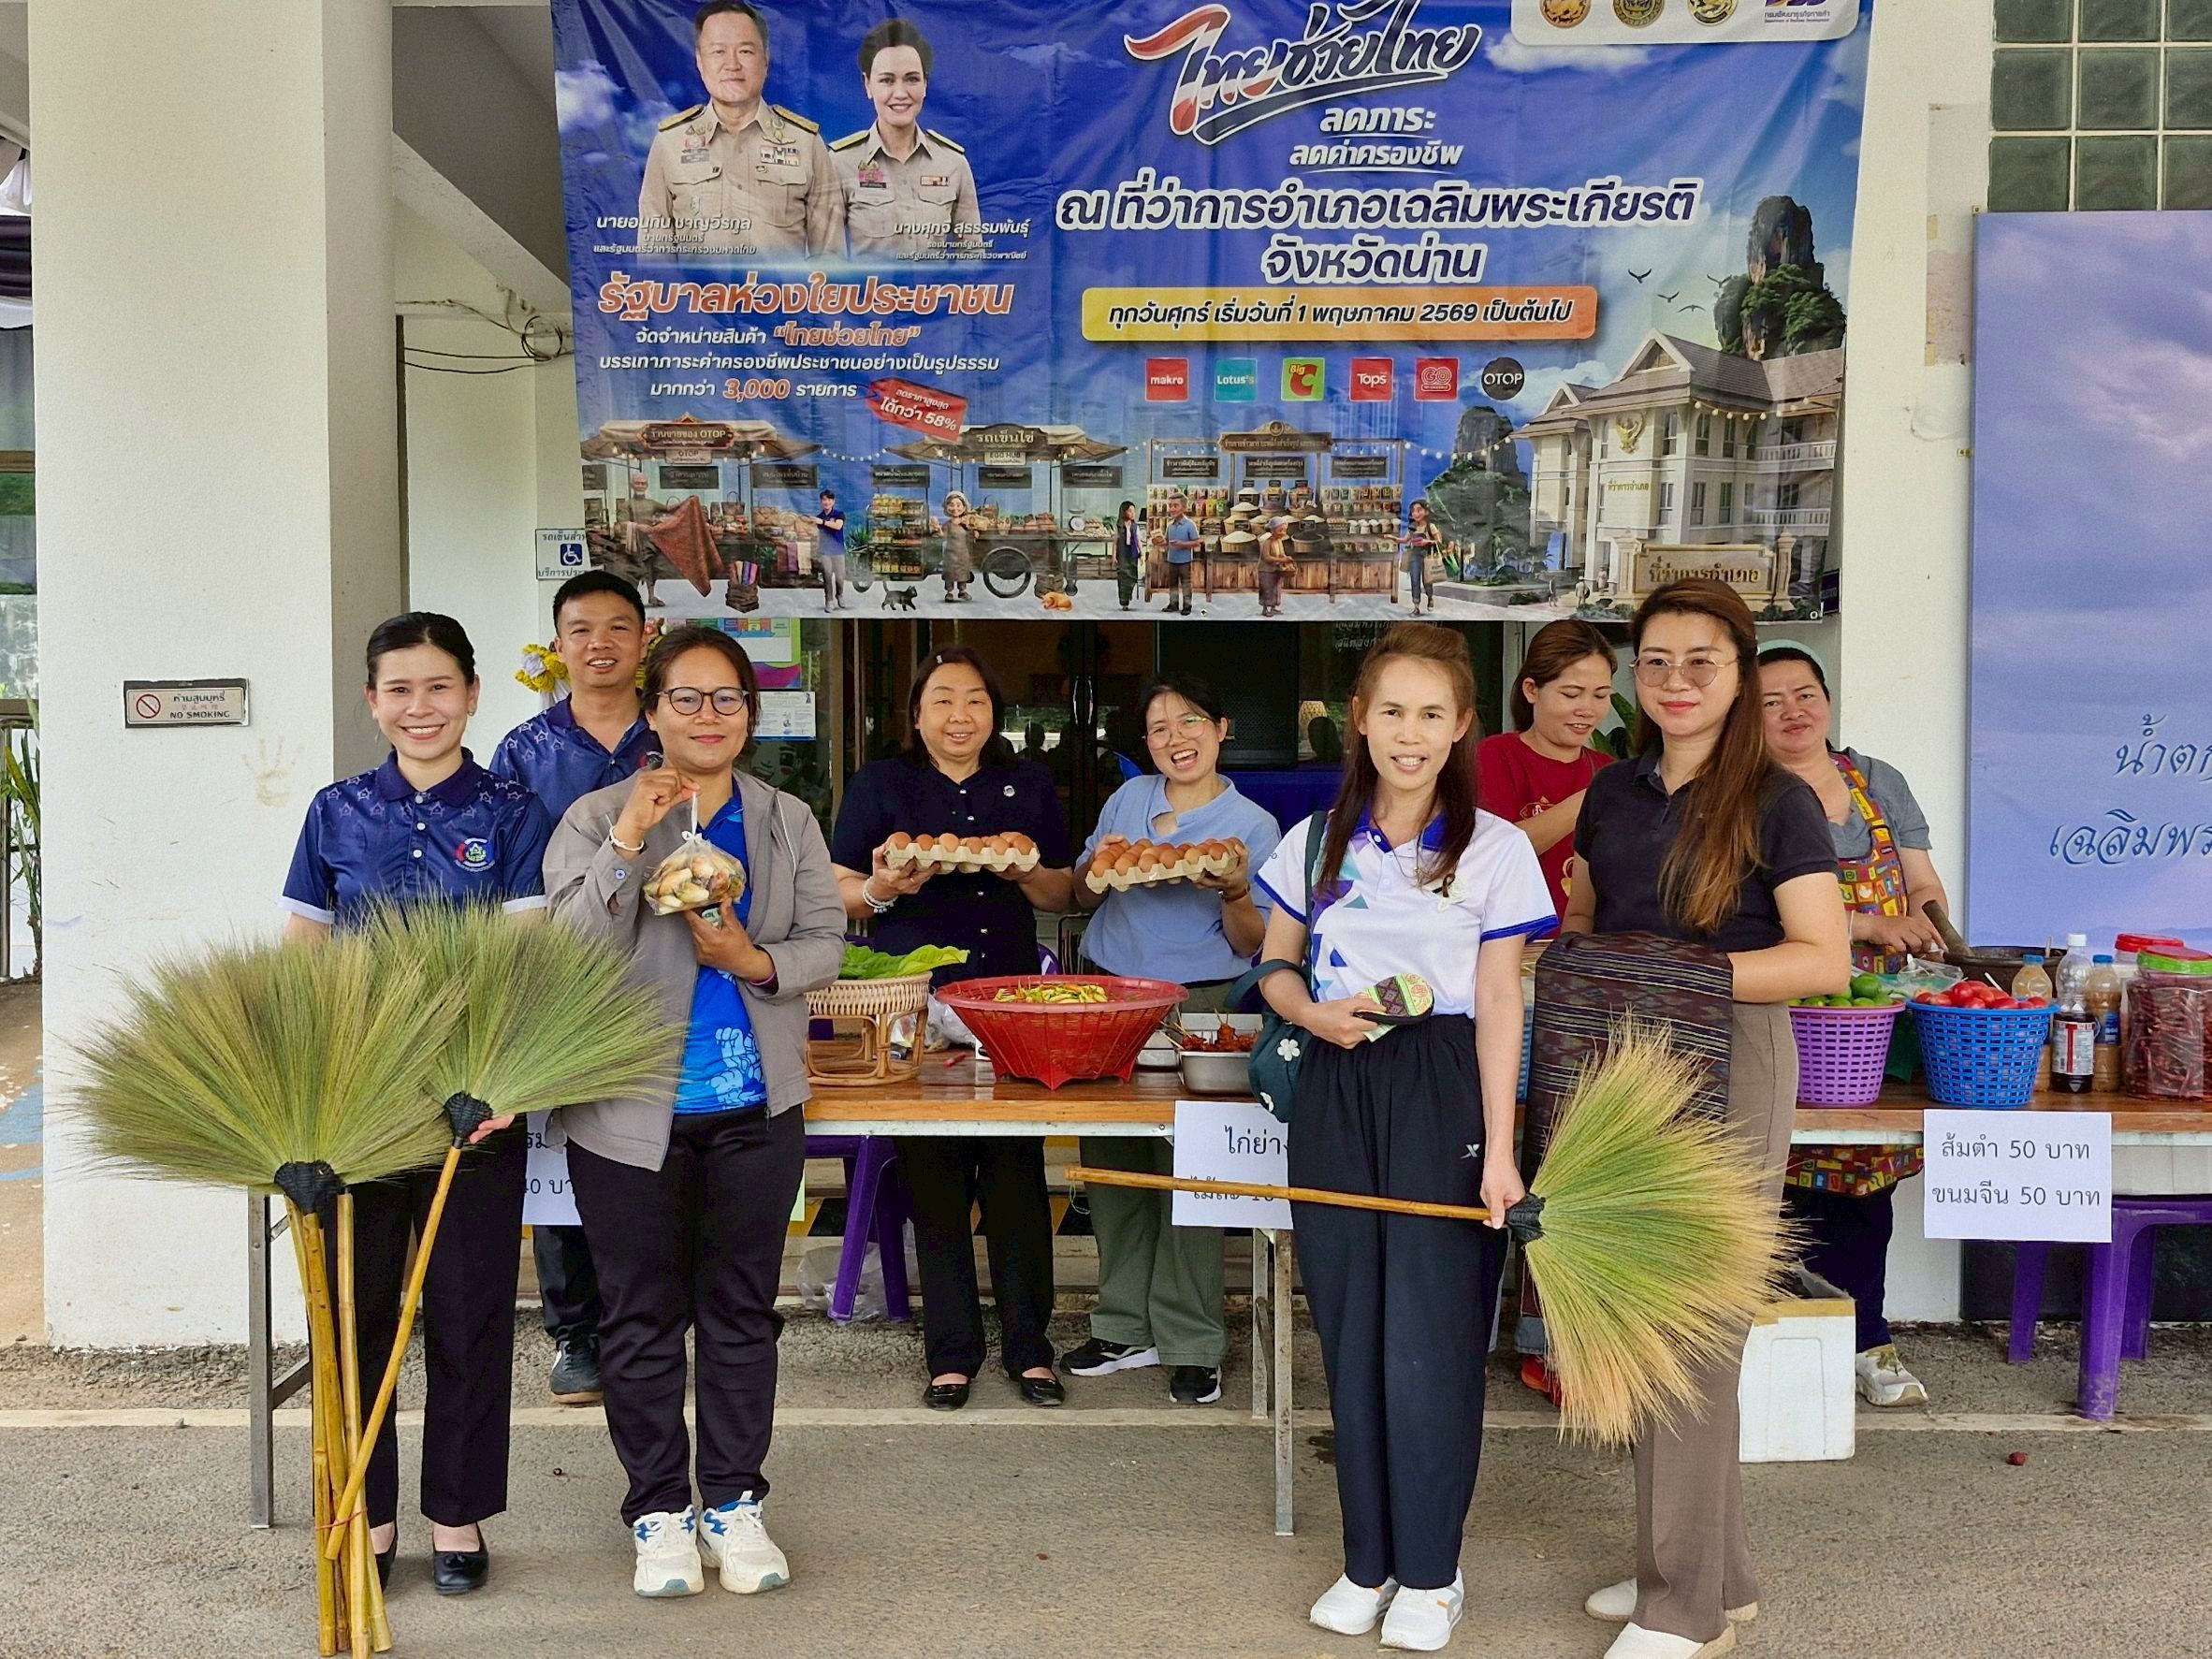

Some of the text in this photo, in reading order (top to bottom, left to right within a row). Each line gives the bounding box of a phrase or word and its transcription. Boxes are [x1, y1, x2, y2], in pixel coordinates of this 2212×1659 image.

[1125, 0, 1482, 136] ไทยช่วยไทย
[1319, 106, 1437, 133] ลดภาระ
[1289, 139, 1463, 167] ลดค่าครองชีพ
[1058, 169, 1702, 229] ณ ที่ว่าการอำเภอเฉลิมพระเกียรติ
[1263, 234, 1486, 283] จังหวัดน่าน
[598, 270, 1015, 322] รัฐบาลห่วงใยประชาชน
[1109, 295, 1573, 329] ทุกวันศุกร์ เริ่มวันที่ 1 พฤษภาคม 2569 เป็นต้นไป
[635, 326, 766, 346] จัดจำหน่ายสินค้า
[599, 352, 1000, 376] บรรเทาภาระค่าครองชีพประชาชนอย่างเป็นรูปธรรม
[1289, 364, 1305, 375] Big
[650, 377, 857, 404] มากกว่า 3,000 รายการ
[1150, 375, 1185, 386] makro
[1357, 373, 1388, 387] Tops
[1483, 372, 1523, 386] OTOP
[699, 429, 726, 438] OTOP
[924, 412, 957, 431] 58%
[976, 429, 1034, 444] รถเข็นไข่
[186, 710, 230, 720] SMOKING
[1224, 1125, 1288, 1155] ไก่ย่า
[1942, 1132, 2090, 1159] ส้มตำ 50 บาท
[1931, 1180, 2101, 1206] ขนมจีน 50 บาท
